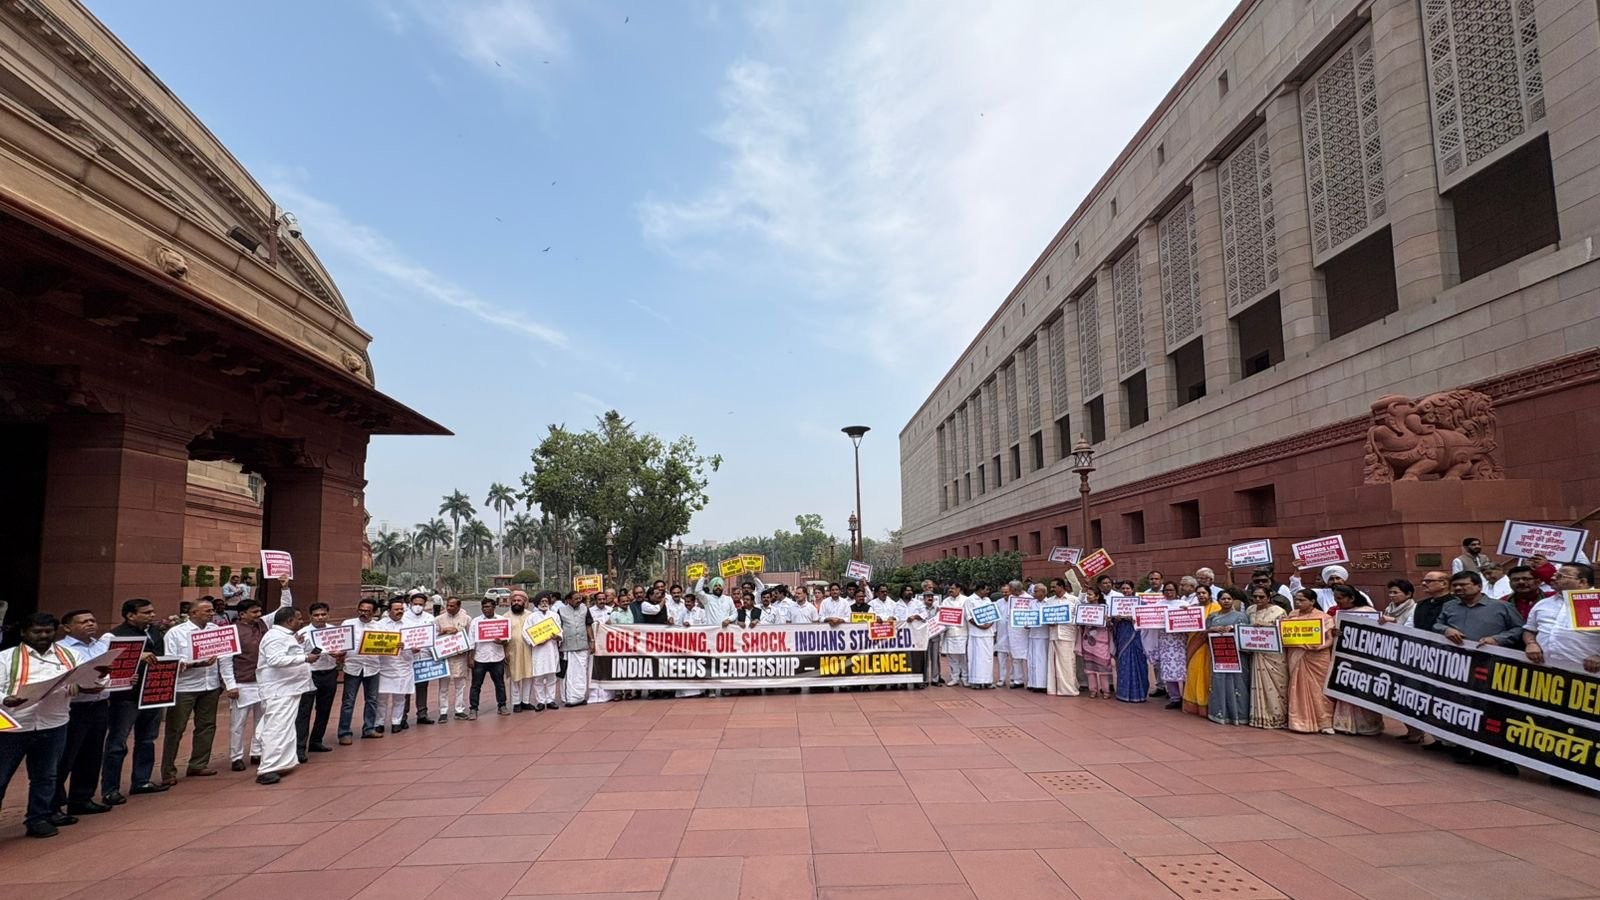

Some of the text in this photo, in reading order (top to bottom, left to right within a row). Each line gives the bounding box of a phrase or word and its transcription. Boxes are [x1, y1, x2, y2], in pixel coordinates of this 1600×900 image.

[1298, 542, 1322, 551] LEADERS
[192, 631, 218, 640] LEADERS
[606, 631, 641, 654] GULF
[645, 631, 711, 655] BURNING,
[716, 631, 738, 654] OIL
[742, 631, 791, 653] SHOCK.
[795, 630, 846, 652] INDIANS
[611, 658, 653, 679] INDIA
[658, 658, 706, 678] NEEDS
[711, 656, 800, 678] LEADERSHIP
[819, 655, 846, 675] NOT
[851, 653, 912, 674] SILENCE.
[1341, 625, 1399, 662] SILENCING
[1400, 639, 1472, 683] OPPOSITION
[1491, 662, 1565, 706] KILLING
[1335, 661, 1372, 694] विपक्ष
[1372, 672, 1392, 700] की
[1391, 682, 1432, 716] आवाज़
[1432, 696, 1484, 733] दबाना
[1506, 714, 1594, 766] लोकतंत्र
